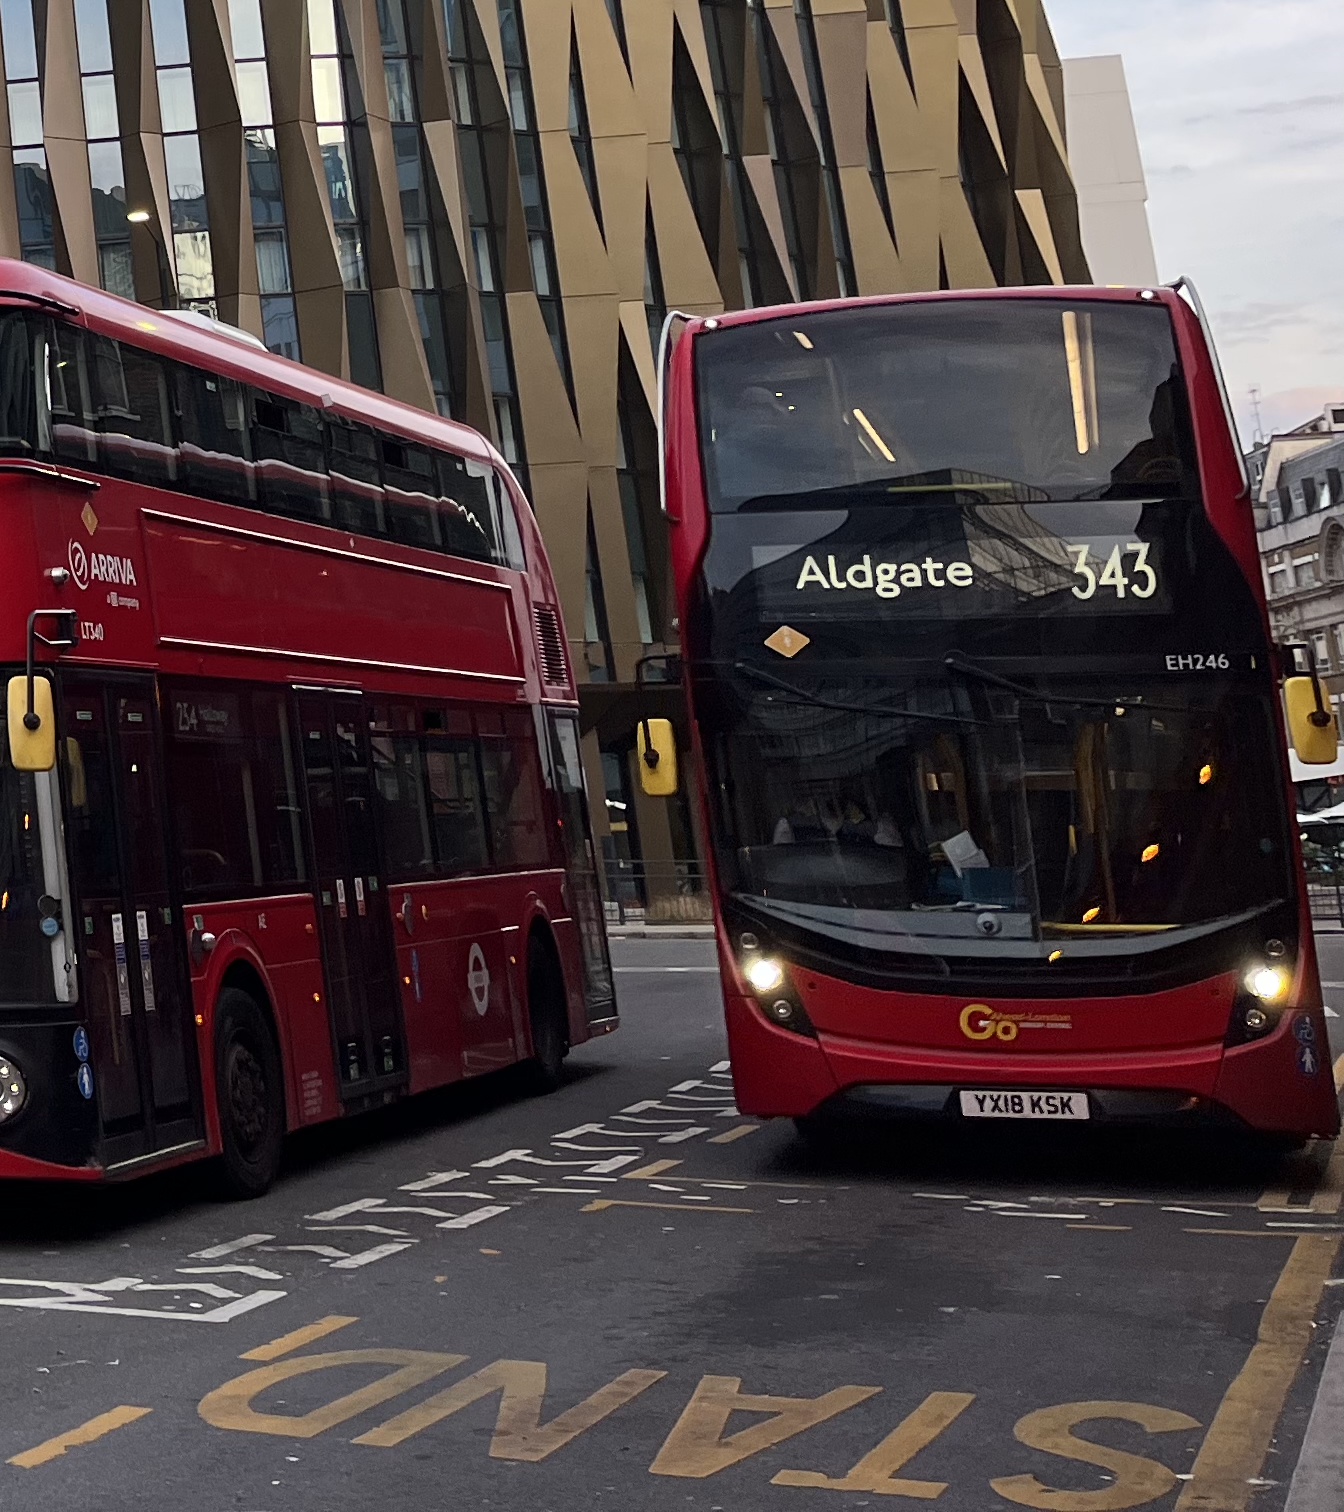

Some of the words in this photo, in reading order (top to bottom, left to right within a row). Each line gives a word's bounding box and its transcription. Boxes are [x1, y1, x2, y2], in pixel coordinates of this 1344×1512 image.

[90, 552, 137, 587] ARRIVA
[796, 554, 974, 598] Aldgate
[1066, 541, 1158, 600] 343
[80, 621, 104, 641] LT340
[1165, 653, 1230, 671] EH246
[959, 1003, 1018, 1041] Go
[974, 1094, 1024, 1114] YX18
[1029, 1095, 1075, 1116] KSK
[195, 1347, 1205, 1511] STAND
